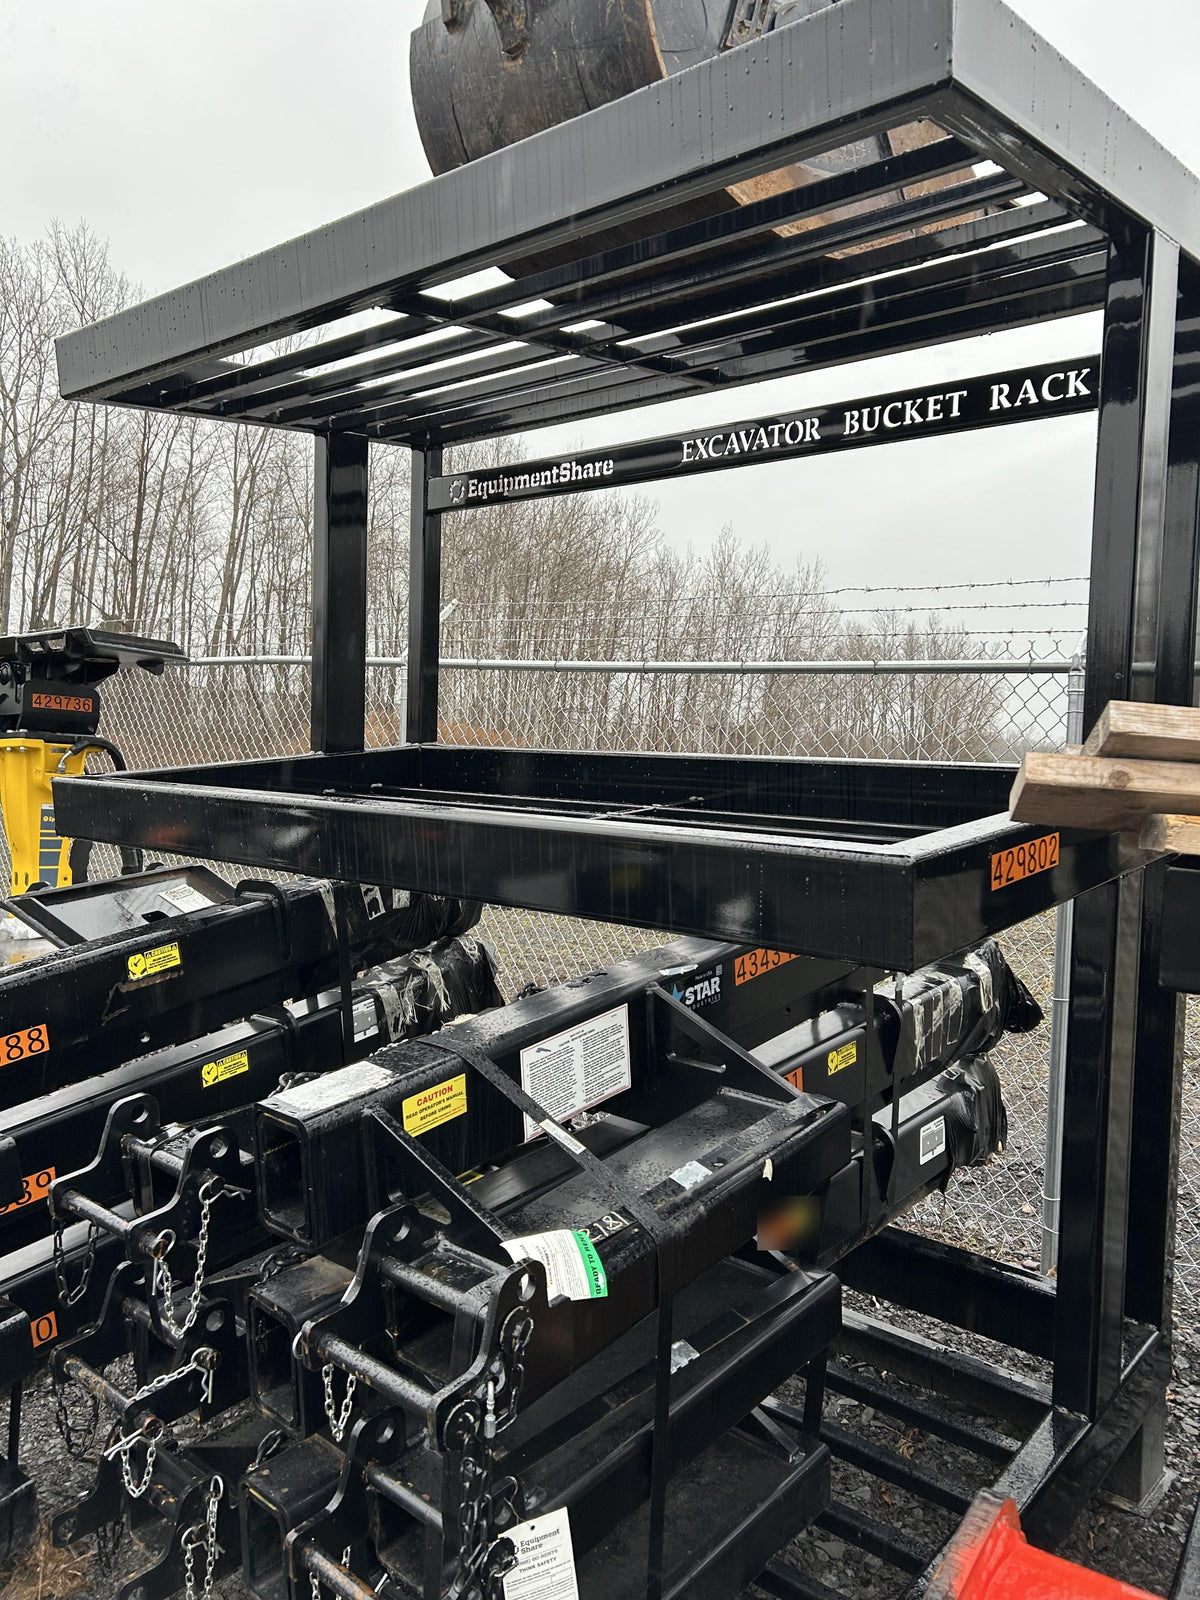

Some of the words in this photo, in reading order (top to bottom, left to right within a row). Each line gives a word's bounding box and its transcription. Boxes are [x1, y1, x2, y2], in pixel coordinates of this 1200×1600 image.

[681, 417, 822, 463] EXCAVATOR
[843, 390, 968, 435] BUCKET
[989, 367, 1092, 411] RACK
[467, 459, 614, 499] EquipmentShare
[33, 694, 91, 712] 429736
[993, 834, 1058, 886] 429802
[685, 976, 721, 1005] STAR
[416, 1085, 453, 1107] CAUTION
[420, 1110, 437, 1121] BEFORE
[438, 1103, 452, 1113] USING
[586, 1253, 595, 1265] TO
[591, 1266, 602, 1295] READY
[520, 1528, 560, 1548] Equipment
[520, 1543, 544, 1555] Share
[519, 1564, 536, 1573] THINK
[537, 1556, 557, 1567] SAFETY
